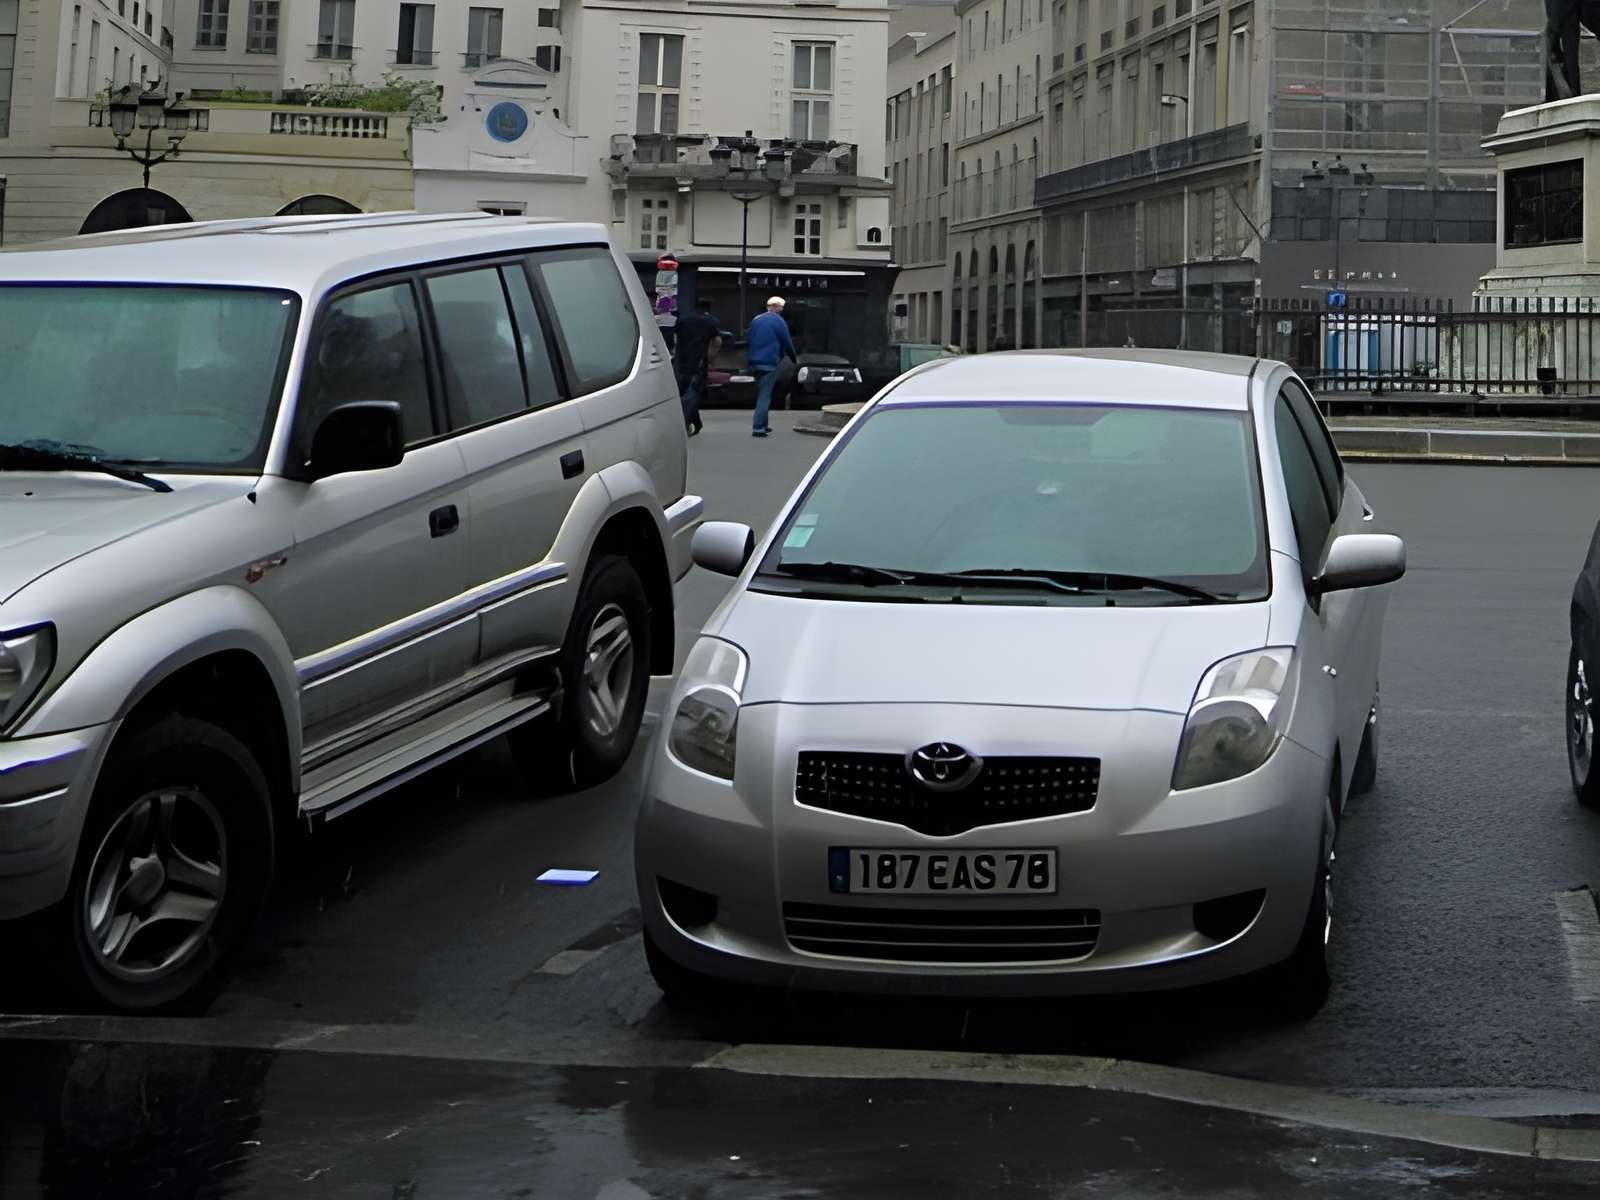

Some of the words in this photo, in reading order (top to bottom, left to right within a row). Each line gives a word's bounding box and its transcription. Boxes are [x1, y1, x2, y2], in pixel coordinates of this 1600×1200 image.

[860, 854, 920, 889] 187
[927, 854, 997, 890] EAS
[1005, 853, 1050, 890] 78
